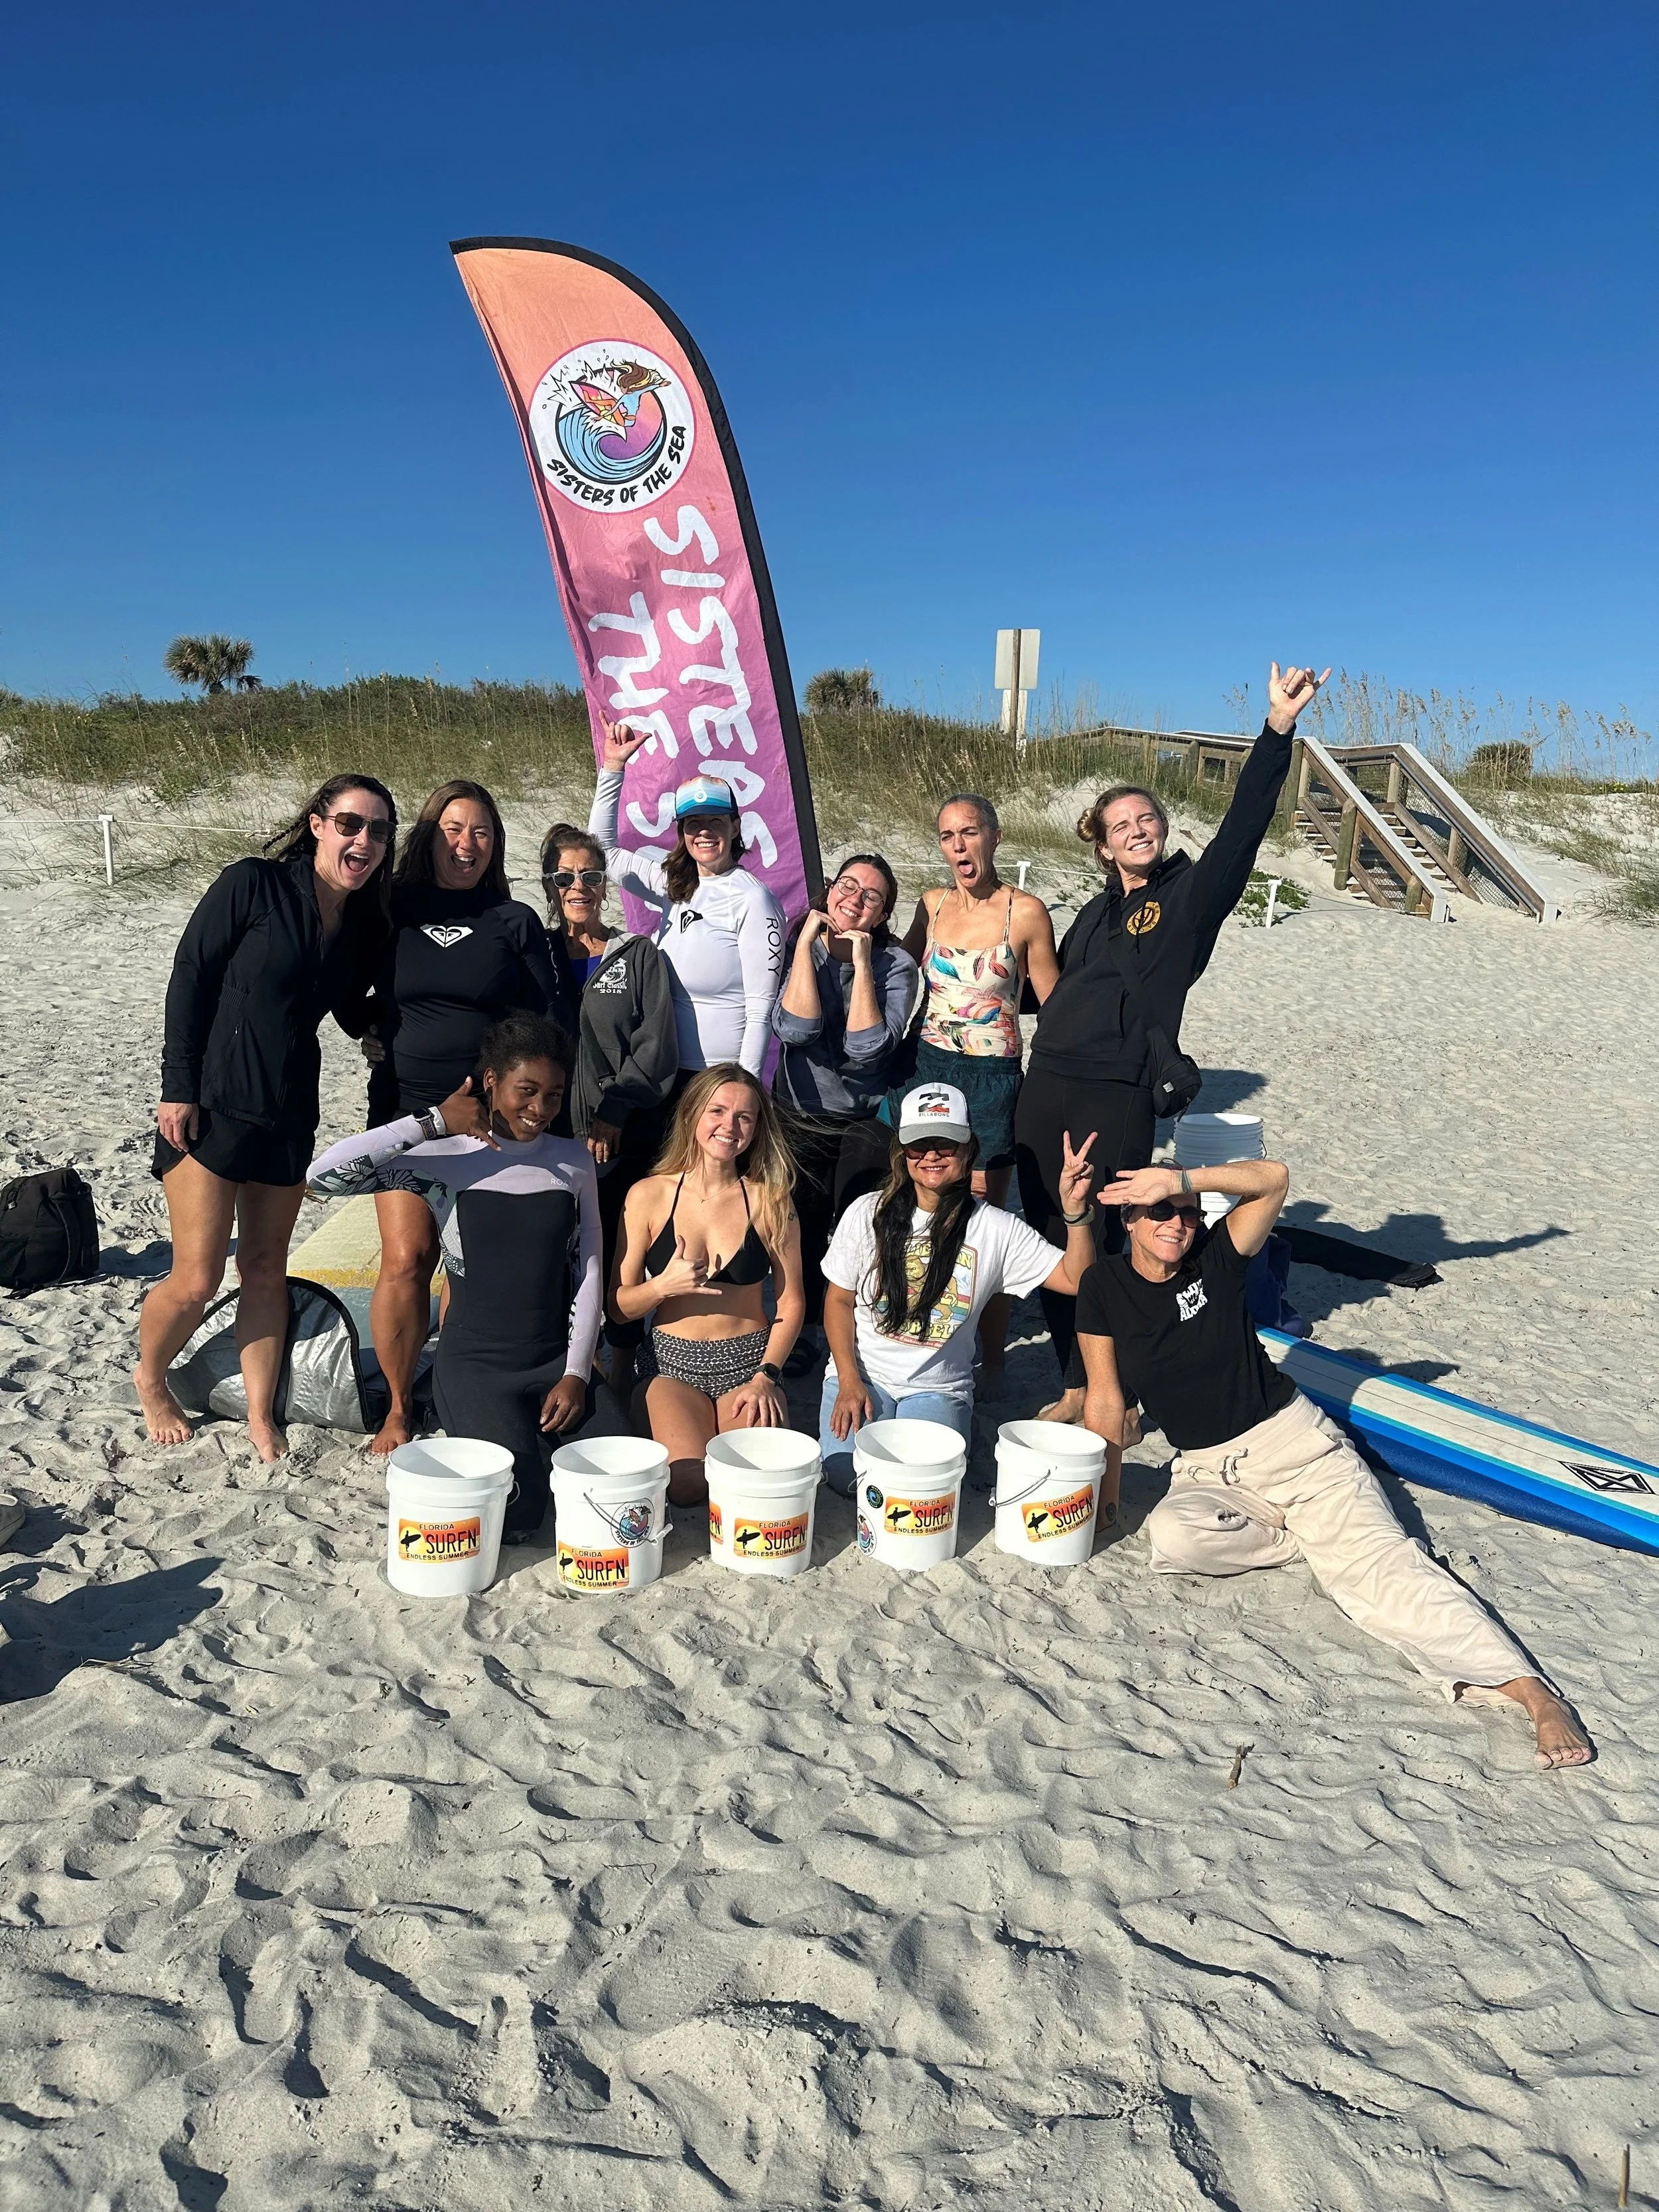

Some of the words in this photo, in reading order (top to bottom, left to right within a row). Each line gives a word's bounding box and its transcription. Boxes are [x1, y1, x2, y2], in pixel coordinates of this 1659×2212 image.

[546, 459, 615, 506] SISTERS
[620, 484, 638, 503] OF
[642, 463, 672, 494] THE
[668, 425, 687, 465] SEA
[766, 917, 782, 977] ROXY
[1044, 1495, 1075, 1508] FLORIDA
[1052, 1494, 1092, 1528] SURFN
[914, 1501, 954, 1528] SURFN
[1038, 1526, 1067, 1539] ENDLESS
[1068, 1514, 1090, 1530] SUMMER
[764, 1524, 806, 1550] SURFN
[924, 1523, 948, 1533] SUMMER
[425, 1528, 476, 1554] SURFN
[571, 1548, 603, 1558] FLORIDA
[775, 1546, 800, 1556] SUMMER
[438, 1550, 469, 1560] SUMMER
[577, 1558, 625, 1581] SURFN
